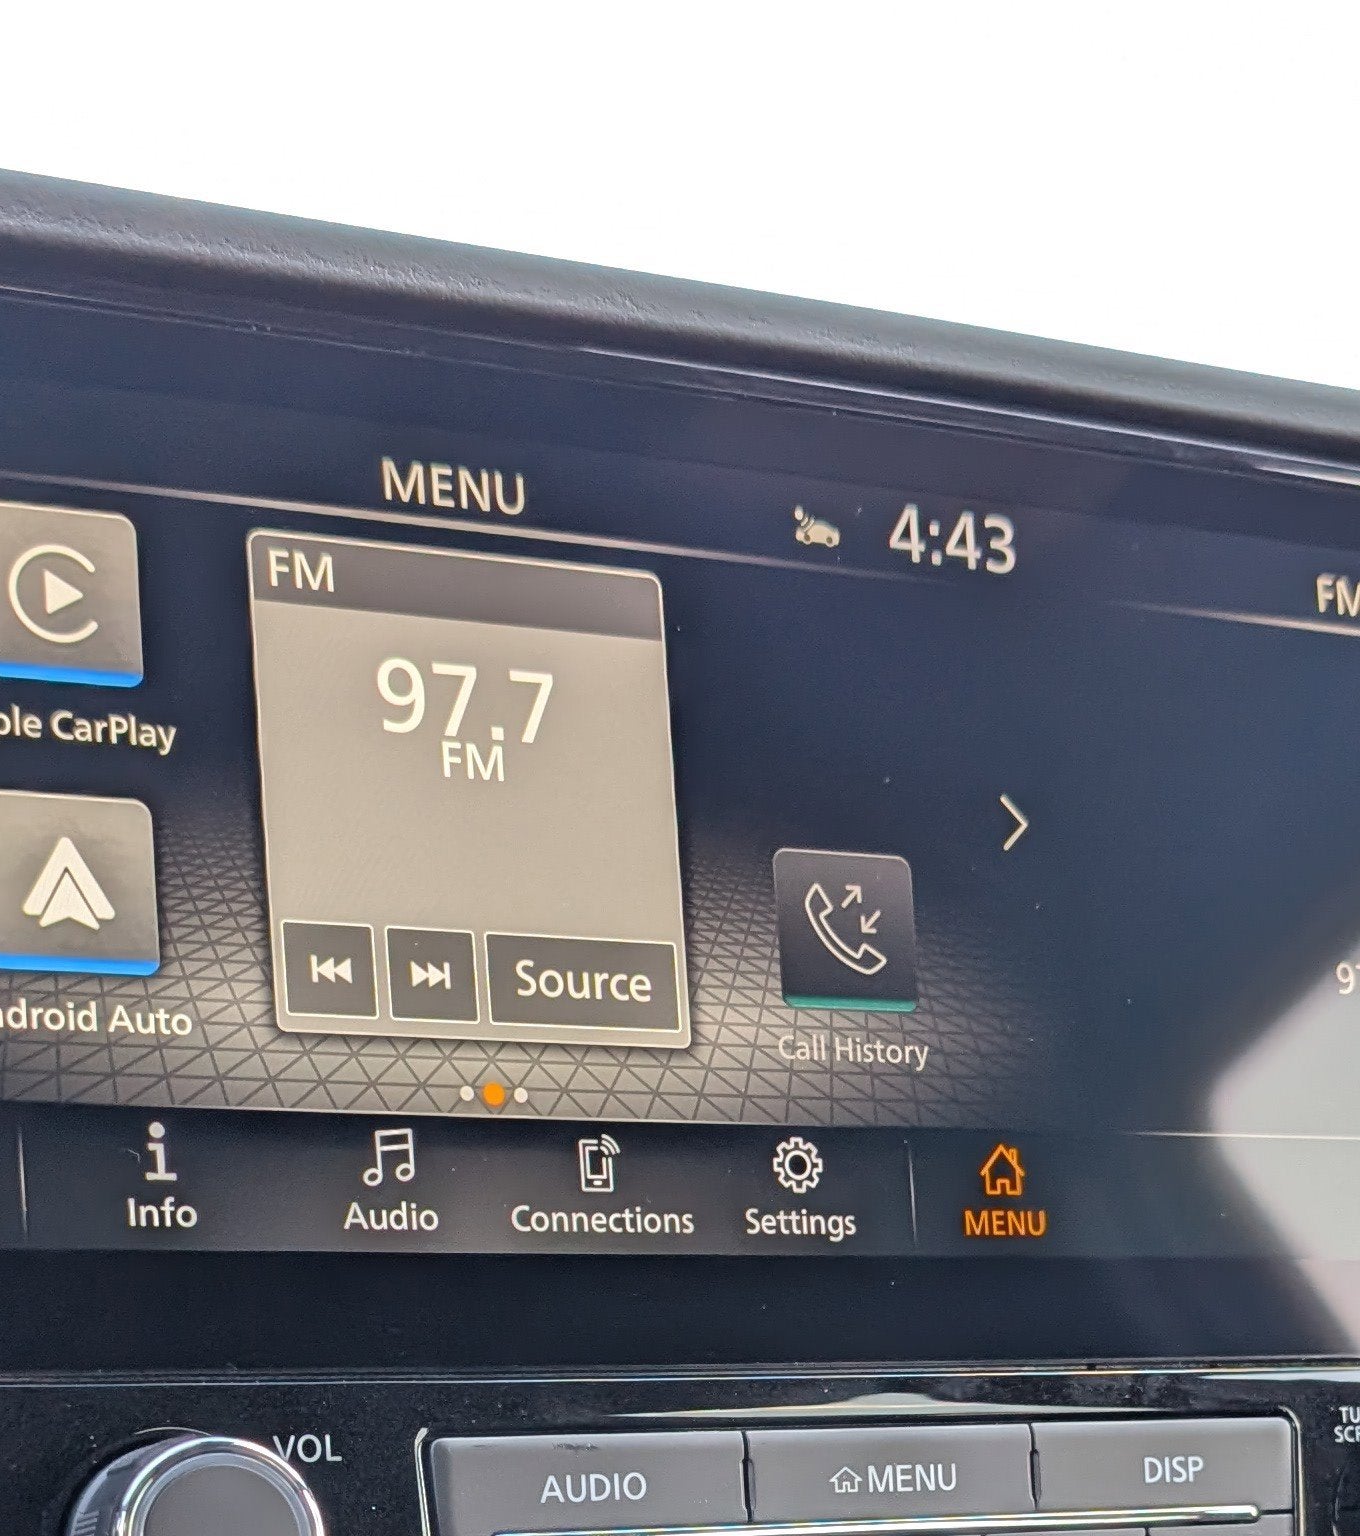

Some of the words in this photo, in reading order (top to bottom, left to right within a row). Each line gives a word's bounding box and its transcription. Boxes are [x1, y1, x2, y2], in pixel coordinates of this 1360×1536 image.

[380, 456, 527, 516] MENU
[887, 503, 1018, 575] 4:43
[268, 550, 336, 594] FM
[375, 657, 555, 746] 97.7
[50, 709, 178, 757] CarPlay
[440, 740, 506, 783] FM
[514, 958, 653, 1004] Source
[107, 1003, 194, 1037] Auto
[777, 1034, 827, 1063] Call
[833, 1036, 930, 1070] History
[126, 1196, 199, 1231] Info
[342, 1199, 440, 1233] Audio
[510, 1204, 695, 1236] Connections
[744, 1207, 858, 1242] Settings
[963, 1208, 1049, 1238] MENU
[273, 1433, 343, 1464] VOL
[540, 1471, 648, 1504] AUDIO
[867, 1463, 958, 1494] MENU
[1143, 1455, 1205, 1485] DISP
